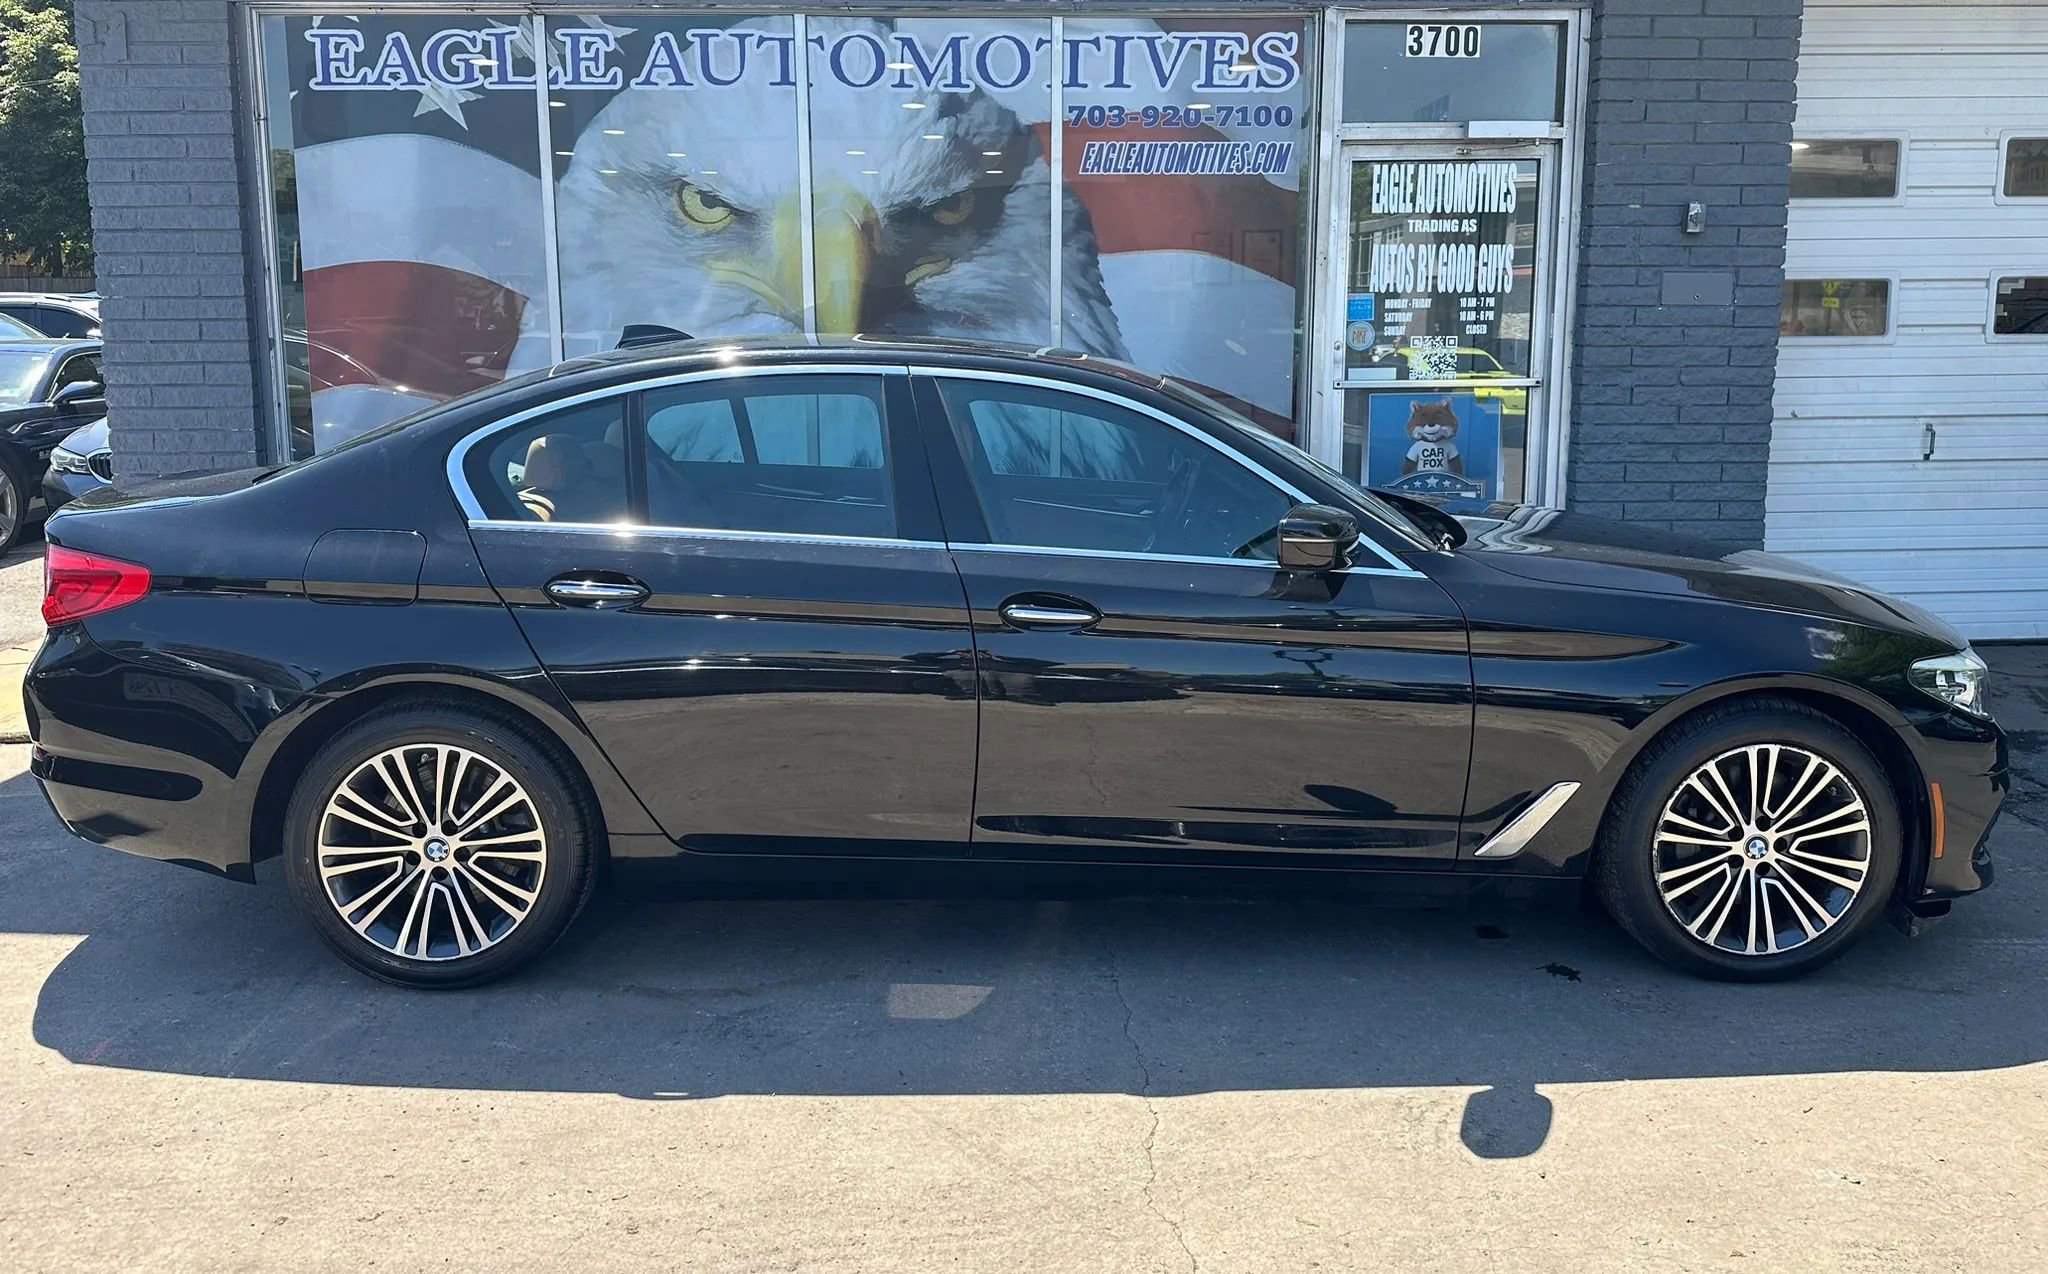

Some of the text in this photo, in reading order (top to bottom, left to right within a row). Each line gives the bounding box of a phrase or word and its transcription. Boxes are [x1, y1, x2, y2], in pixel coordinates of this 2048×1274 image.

[1408, 25, 1479, 57] 3700
[307, 29, 1299, 93] EAGLE AUTOMOTIVES
[1068, 104, 1294, 129] 703-920-7100
[1079, 140, 1293, 176] EAGLEAUTOMOTIVES.COM
[1371, 162, 1517, 214] EAGLE AUTOMOTIVES
[1407, 218, 1477, 233] TRADING AS
[1369, 243, 1515, 294] AUTOS BY GOOD GUYS
[1384, 298, 1409, 309] MONDAY
[1412, 298, 1432, 309] FRIDAY
[1459, 297, 1467, 308] 10
[1467, 297, 1477, 308] AM
[1485, 296, 1495, 307] PM
[1384, 312, 1413, 322] SATURDAY
[1459, 311, 1467, 322] 10
[1467, 311, 1477, 321] AM
[1485, 310, 1494, 321] PM
[1383, 326, 1406, 336] SUNDAY
[1465, 324, 1488, 335] CLOSED
[1422, 448, 1444, 458] CAR
[1423, 458, 1444, 468] FOX
